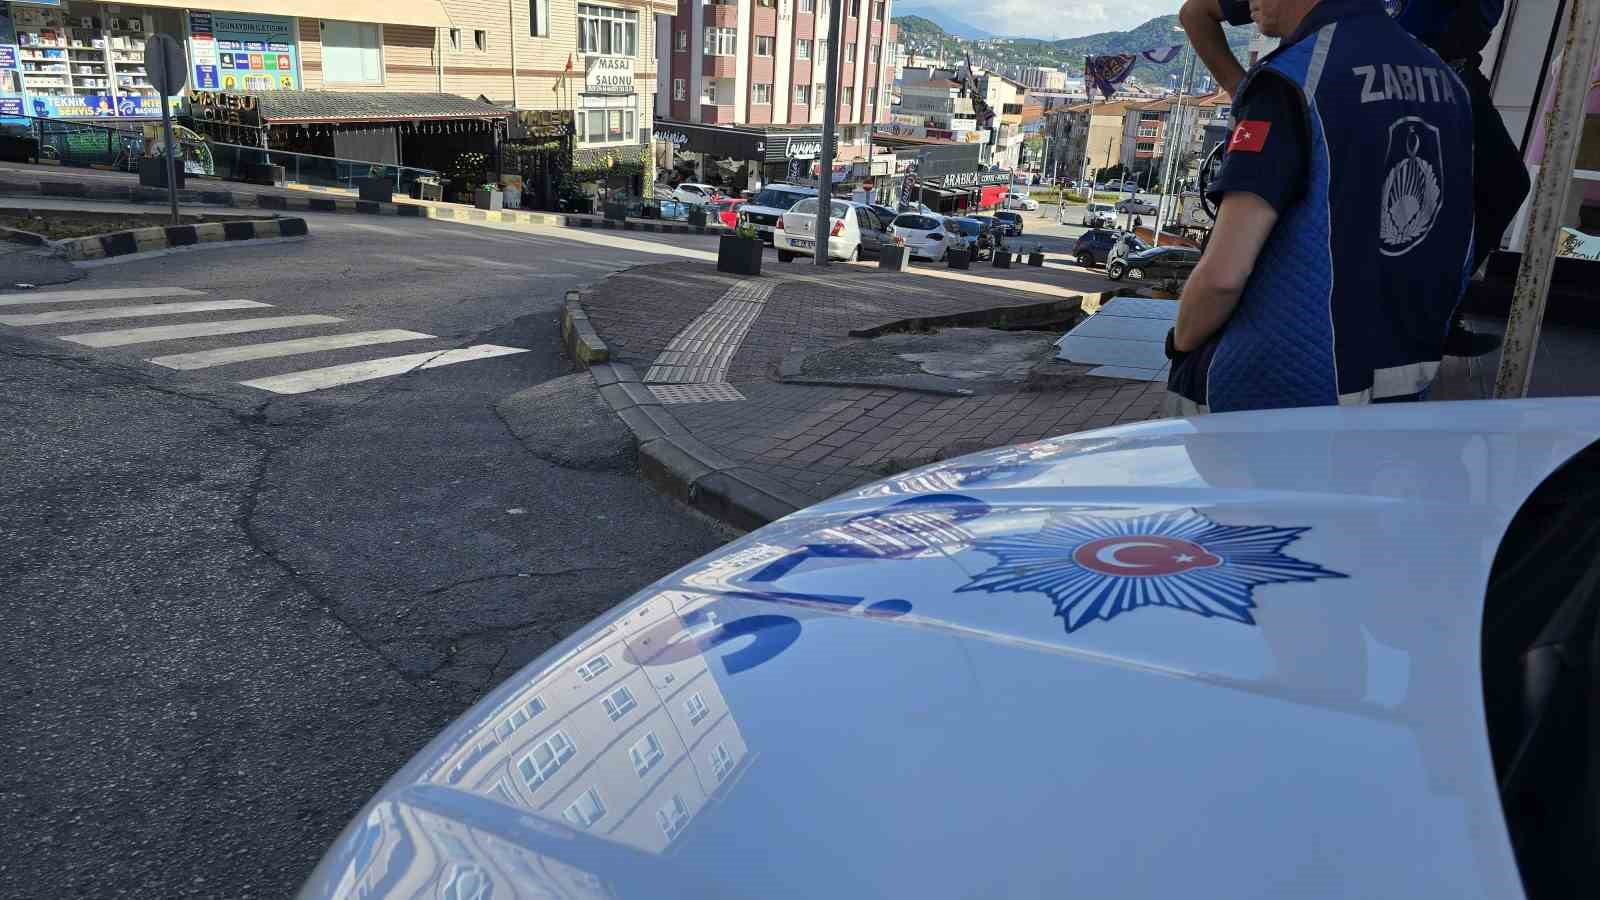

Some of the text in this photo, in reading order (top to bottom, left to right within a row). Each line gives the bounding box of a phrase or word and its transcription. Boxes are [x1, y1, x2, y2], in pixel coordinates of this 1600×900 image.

[599, 59, 629, 70] MASAJ
[595, 75, 632, 86] SALONU
[1352, 63, 1456, 104] ZABITA
[943, 172, 978, 187] ARABICA
